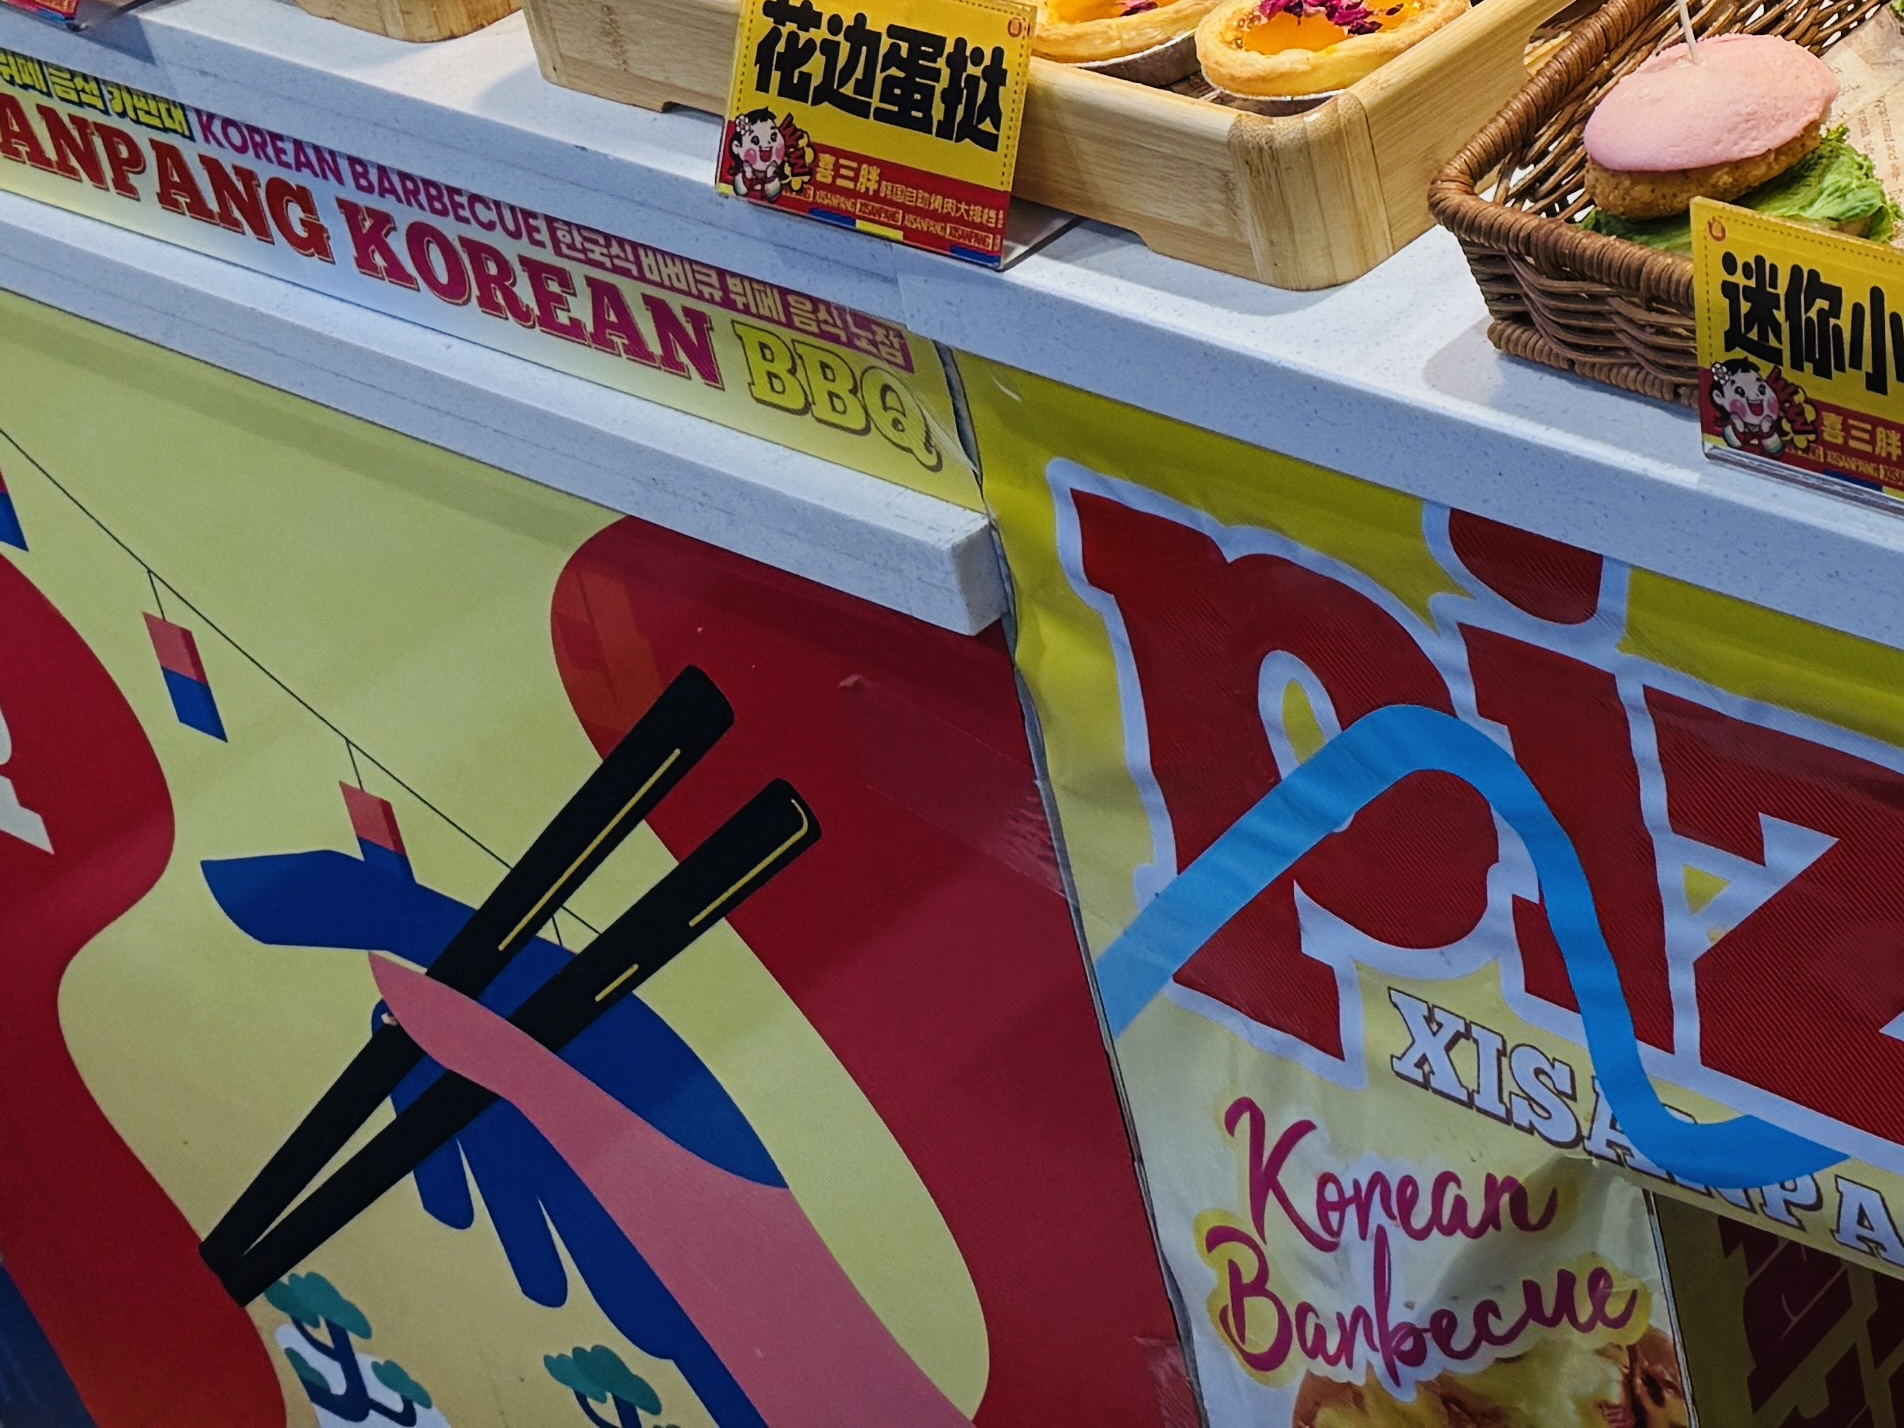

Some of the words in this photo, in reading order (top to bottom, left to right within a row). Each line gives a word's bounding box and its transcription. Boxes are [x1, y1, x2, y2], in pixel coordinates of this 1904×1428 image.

[195, 106, 346, 187] KOREAN
[348, 153, 547, 250] BARBECUE
[815, 152, 881, 196] 喜三胖
[335, 195, 725, 392] KOREAN
[730, 317, 944, 475] BBQ
[556, 217, 636, 278] 한국식
[639, 246, 724, 304] 바비큐
[729, 274, 785, 325] 뷔페
[787, 292, 848, 344] 음식
[1821, 412, 1902, 461] 喜三胖
[1224, 1095, 1559, 1252] Korean
[1204, 1223, 1638, 1389] Barbecue
